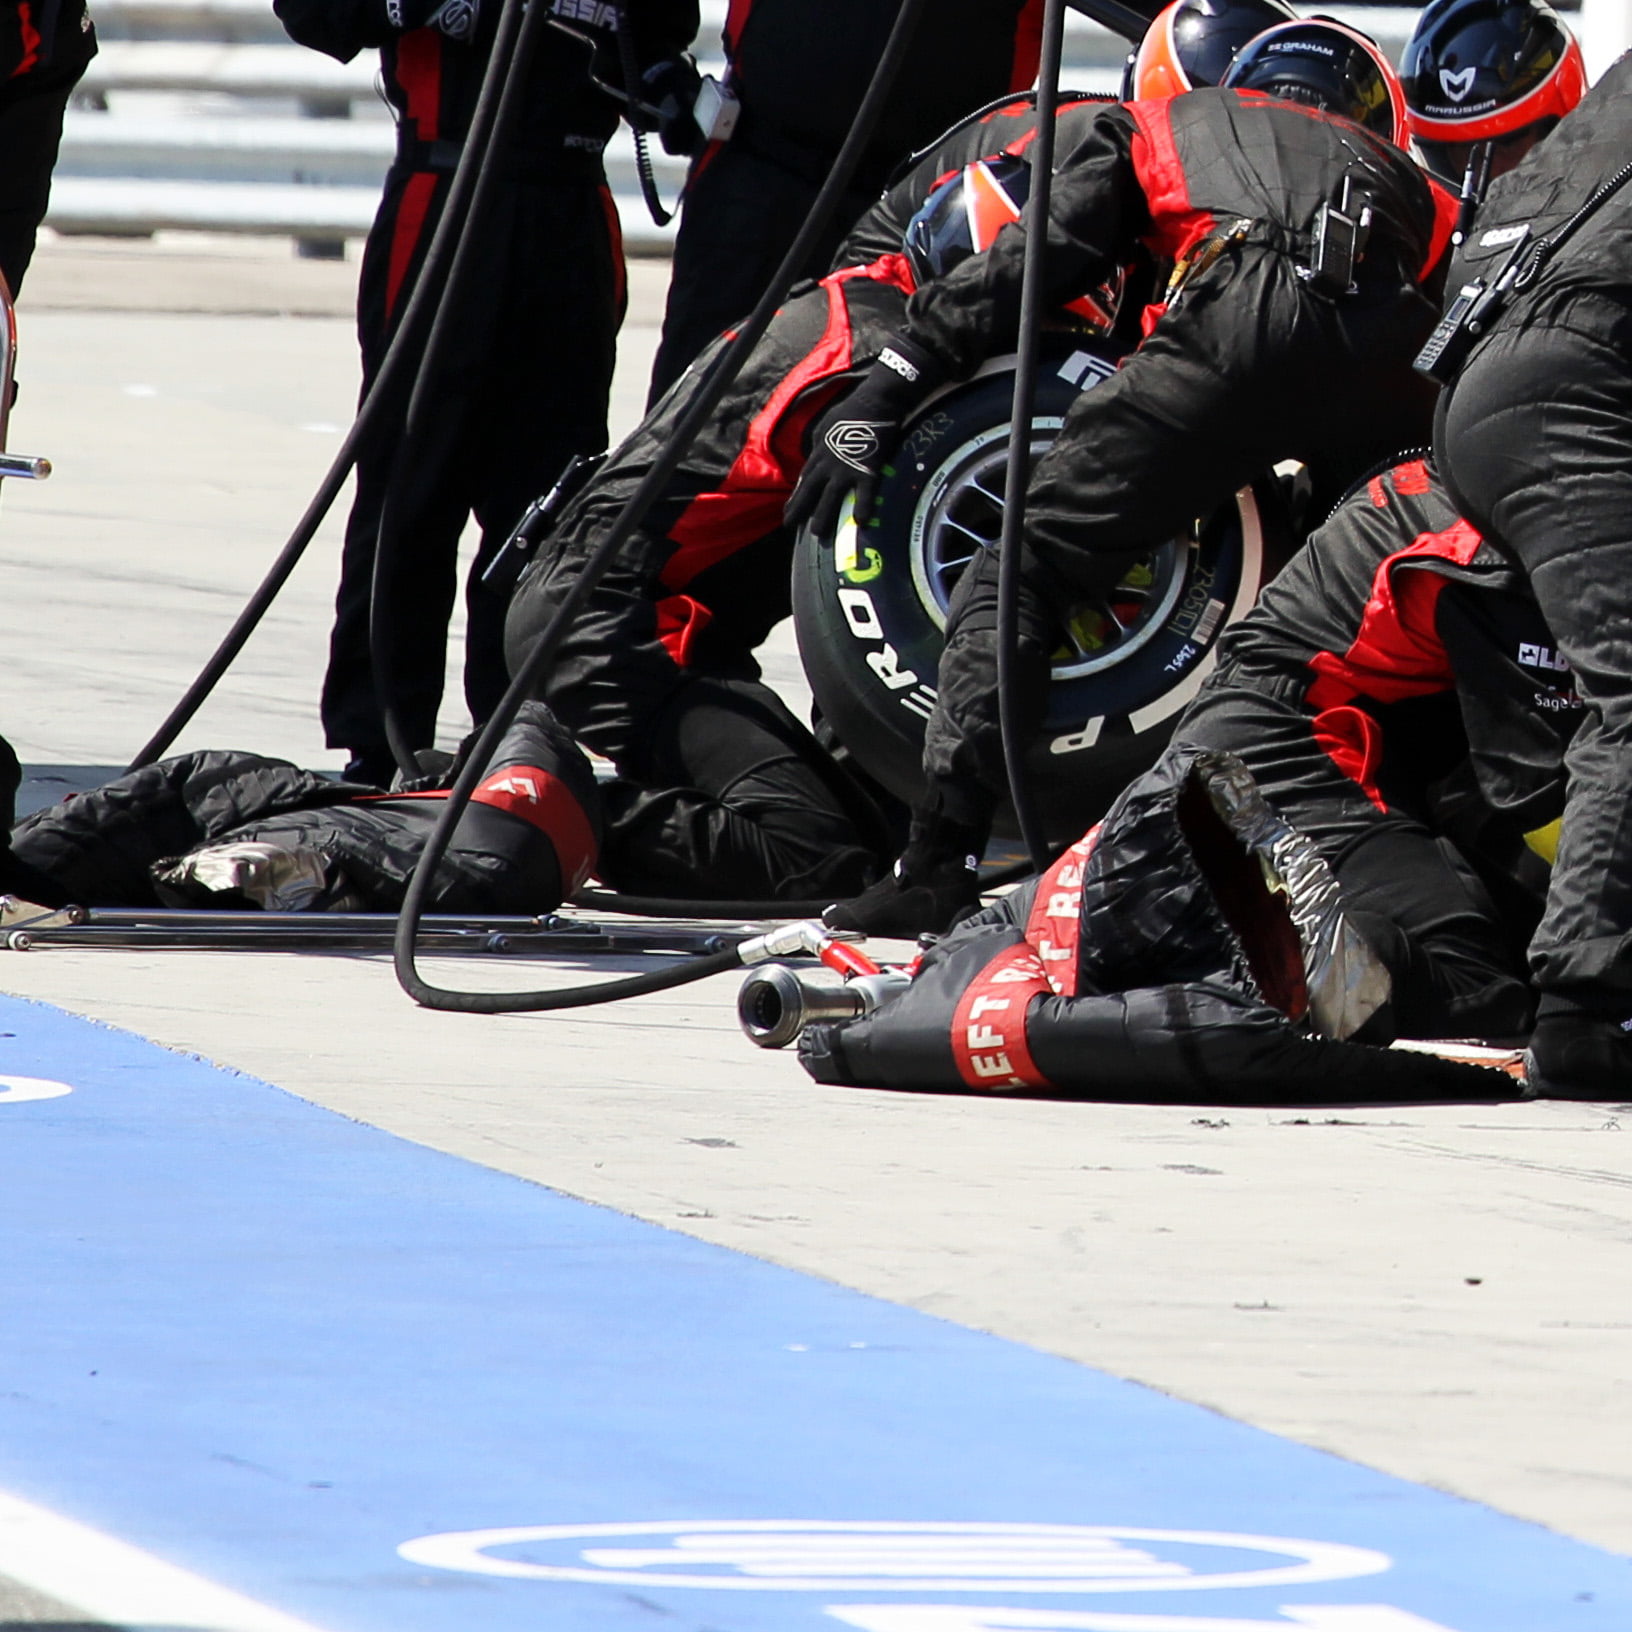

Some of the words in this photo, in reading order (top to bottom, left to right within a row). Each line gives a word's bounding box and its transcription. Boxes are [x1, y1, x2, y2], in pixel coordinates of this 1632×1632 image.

[1283, 41, 1335, 57] GRAHAM
[1424, 98, 1497, 115] MARUSSIA
[1533, 693, 1569, 713] Sage
